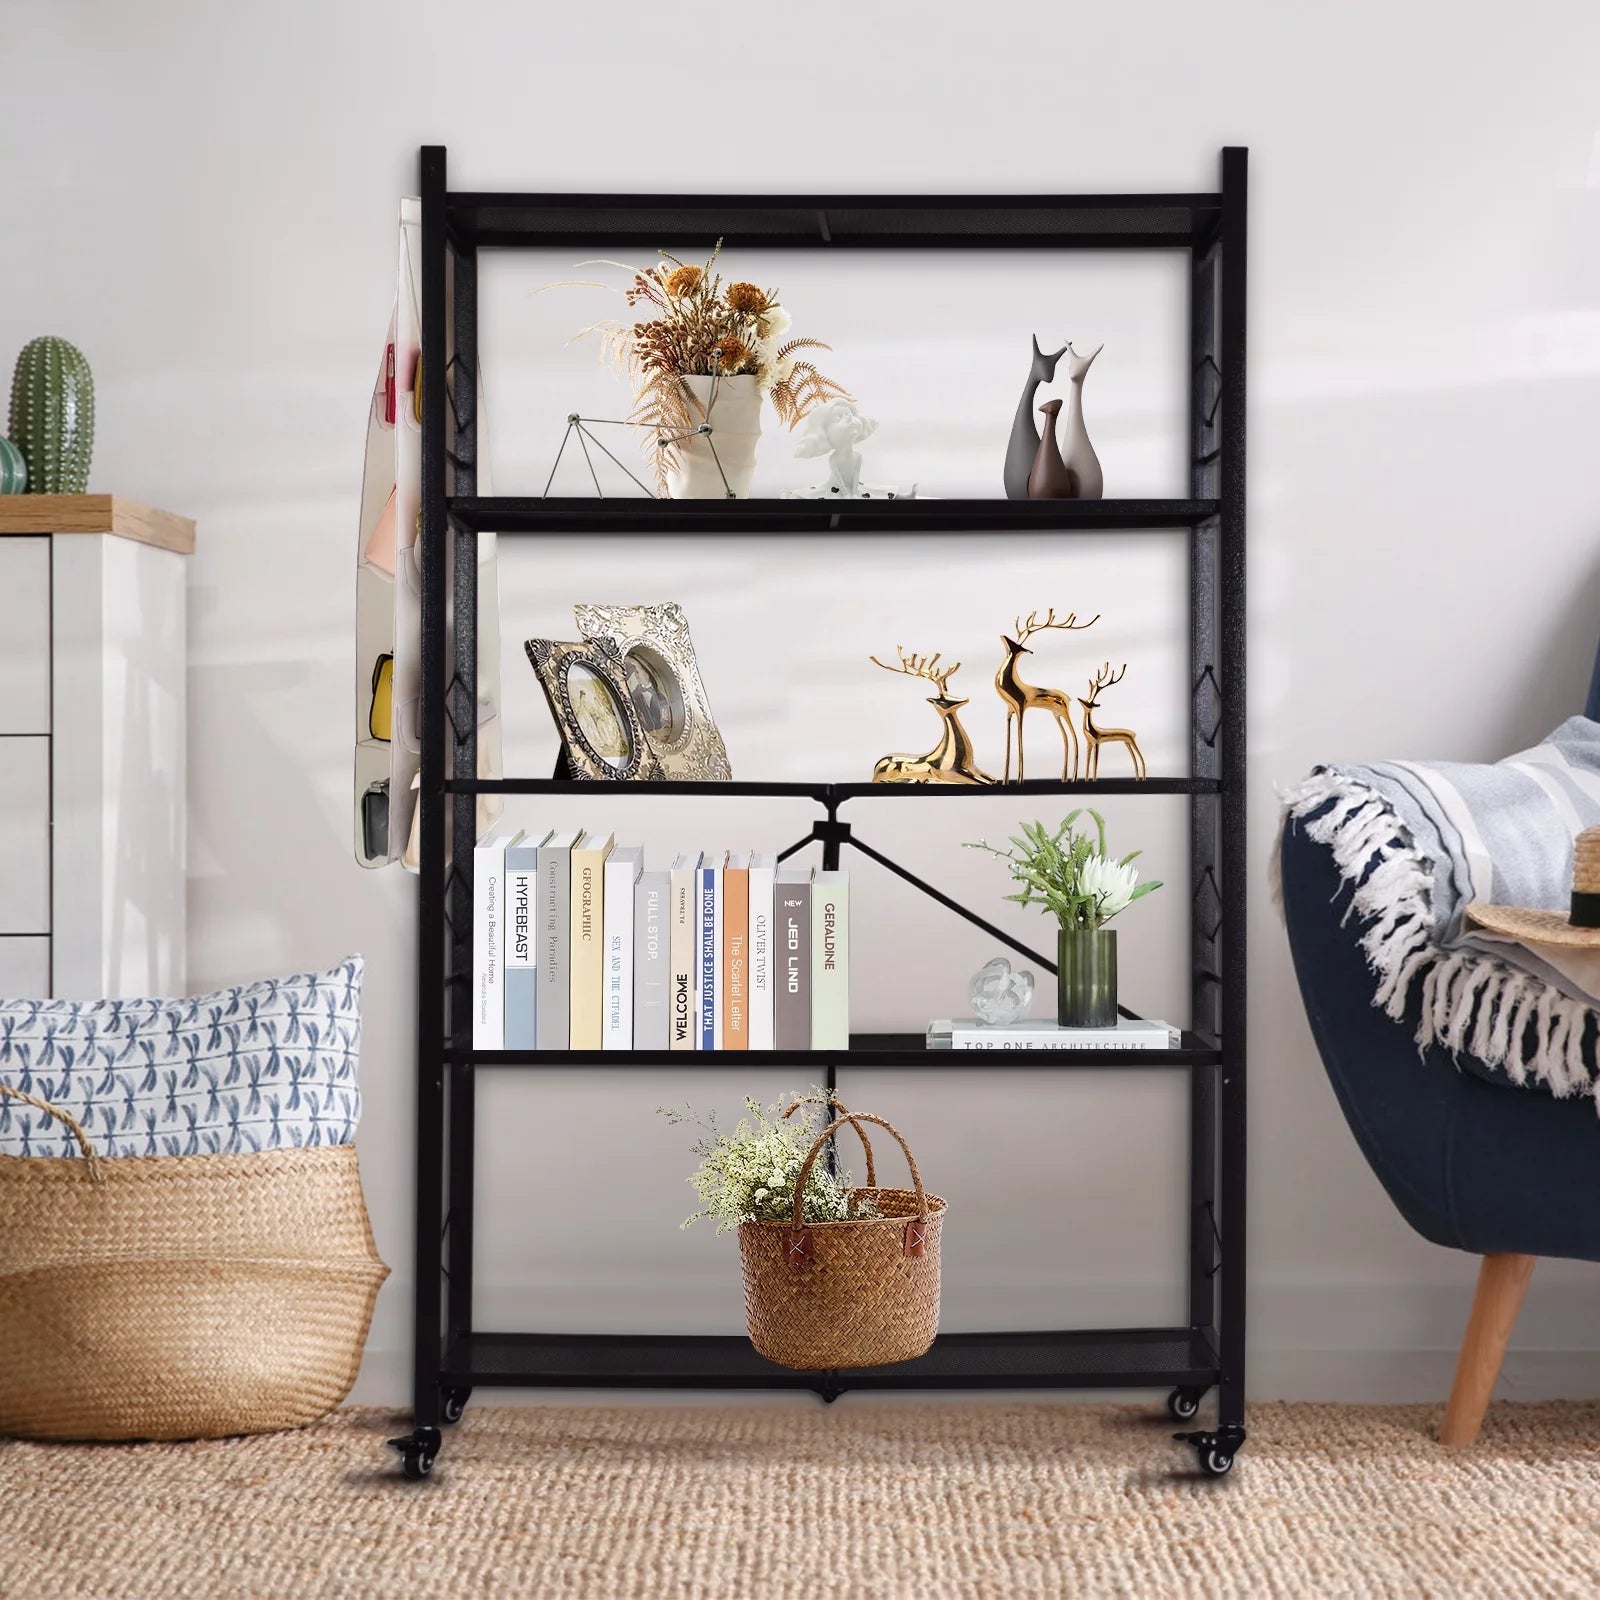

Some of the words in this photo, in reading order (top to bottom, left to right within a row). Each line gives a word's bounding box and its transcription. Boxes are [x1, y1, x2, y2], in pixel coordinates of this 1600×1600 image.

[487, 876, 497, 912] Creating
[547, 861, 558, 931] Constructing
[647, 891, 658, 922] FULL
[704, 888, 714, 914] DONE
[516, 876, 528, 961] HYPEBEAST
[704, 917, 714, 928] BE
[756, 915, 766, 954] OLIVER
[788, 917, 799, 950] JED
[488, 921, 496, 957] Beautiful
[612, 936, 621, 951] SEX
[647, 926, 658, 961] STOP.
[703, 930, 714, 958] SHALL
[731, 936, 743, 956] The
[824, 903, 835, 970] GERALDINE
[487, 959, 496, 984] Home
[549, 936, 559, 983] Paradies
[611, 956, 621, 971] AND
[756, 956, 766, 991] TWIST
[788, 957, 799, 993] LIND
[611, 975, 621, 991] THE
[703, 962, 714, 1001] JUSTICE
[731, 959, 743, 996] Scarlet
[676, 973, 688, 1041] WELCOME
[704, 1005, 714, 1031] THAT
[731, 1000, 743, 1031] Letter
[964, 1042, 994, 1050] TOP
[1003, 1042, 1033, 1050] ONE
[1042, 1042, 1147, 1050] ARCHITECTURE
